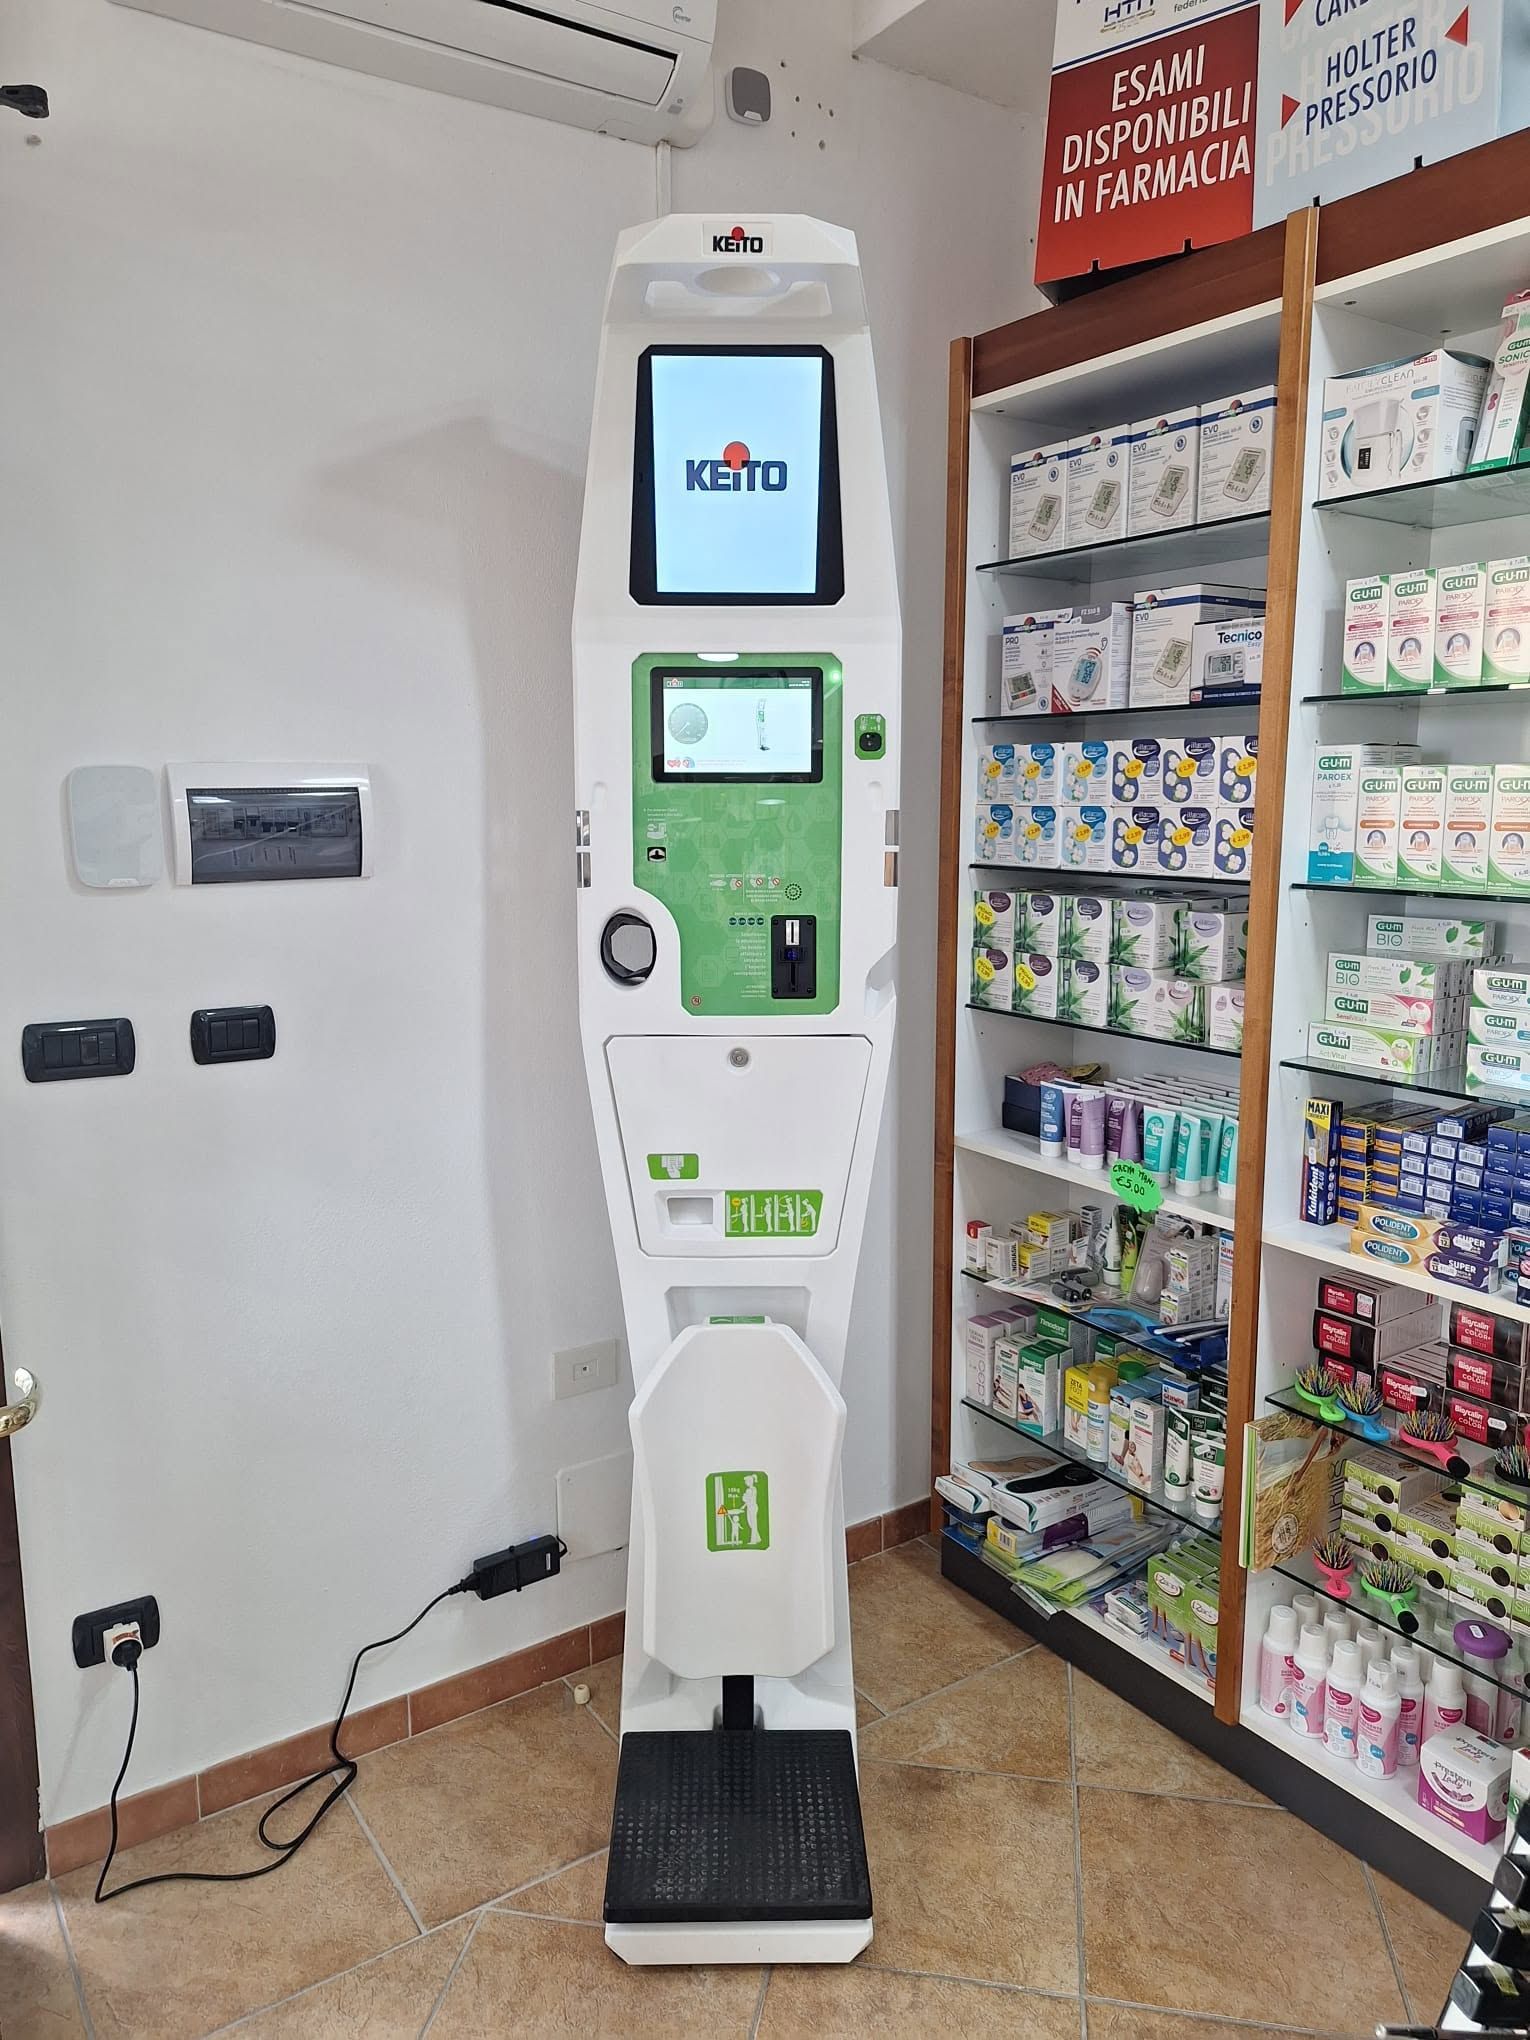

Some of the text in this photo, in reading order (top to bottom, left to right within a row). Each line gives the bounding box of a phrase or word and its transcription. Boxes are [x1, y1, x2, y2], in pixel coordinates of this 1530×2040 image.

[1326, 17, 1417, 88] HOLTER
[1111, 44, 1206, 112] ESAMI
[1305, 49, 1438, 136] PRESSORIO
[1062, 82, 1253, 174] DISPONIBILI
[1054, 136, 1252, 224] IN FARMACIA
[1203, 425, 1218, 435] EVO
[1133, 443, 1146, 453] EVO
[1069, 458, 1082, 468] EVO
[1013, 473, 1025, 482] EVO
[1135, 612, 1149, 621] EVO
[1217, 630, 1262, 644] Tecnico
[1317, 773, 1352, 781] PAROEX
[1377, 934, 1403, 946] BIO
[1335, 972, 1360, 985] BIO
[1308, 1101, 1330, 1115] MAXI
[1307, 1166, 1319, 1217] Kukident
[1375, 1217, 1411, 1233] POLIDENT
[1367, 1241, 1403, 1257] POLIDENT
[1448, 1260, 1476, 1274] SUPER
[1070, 1378, 1082, 1389] ZETA
